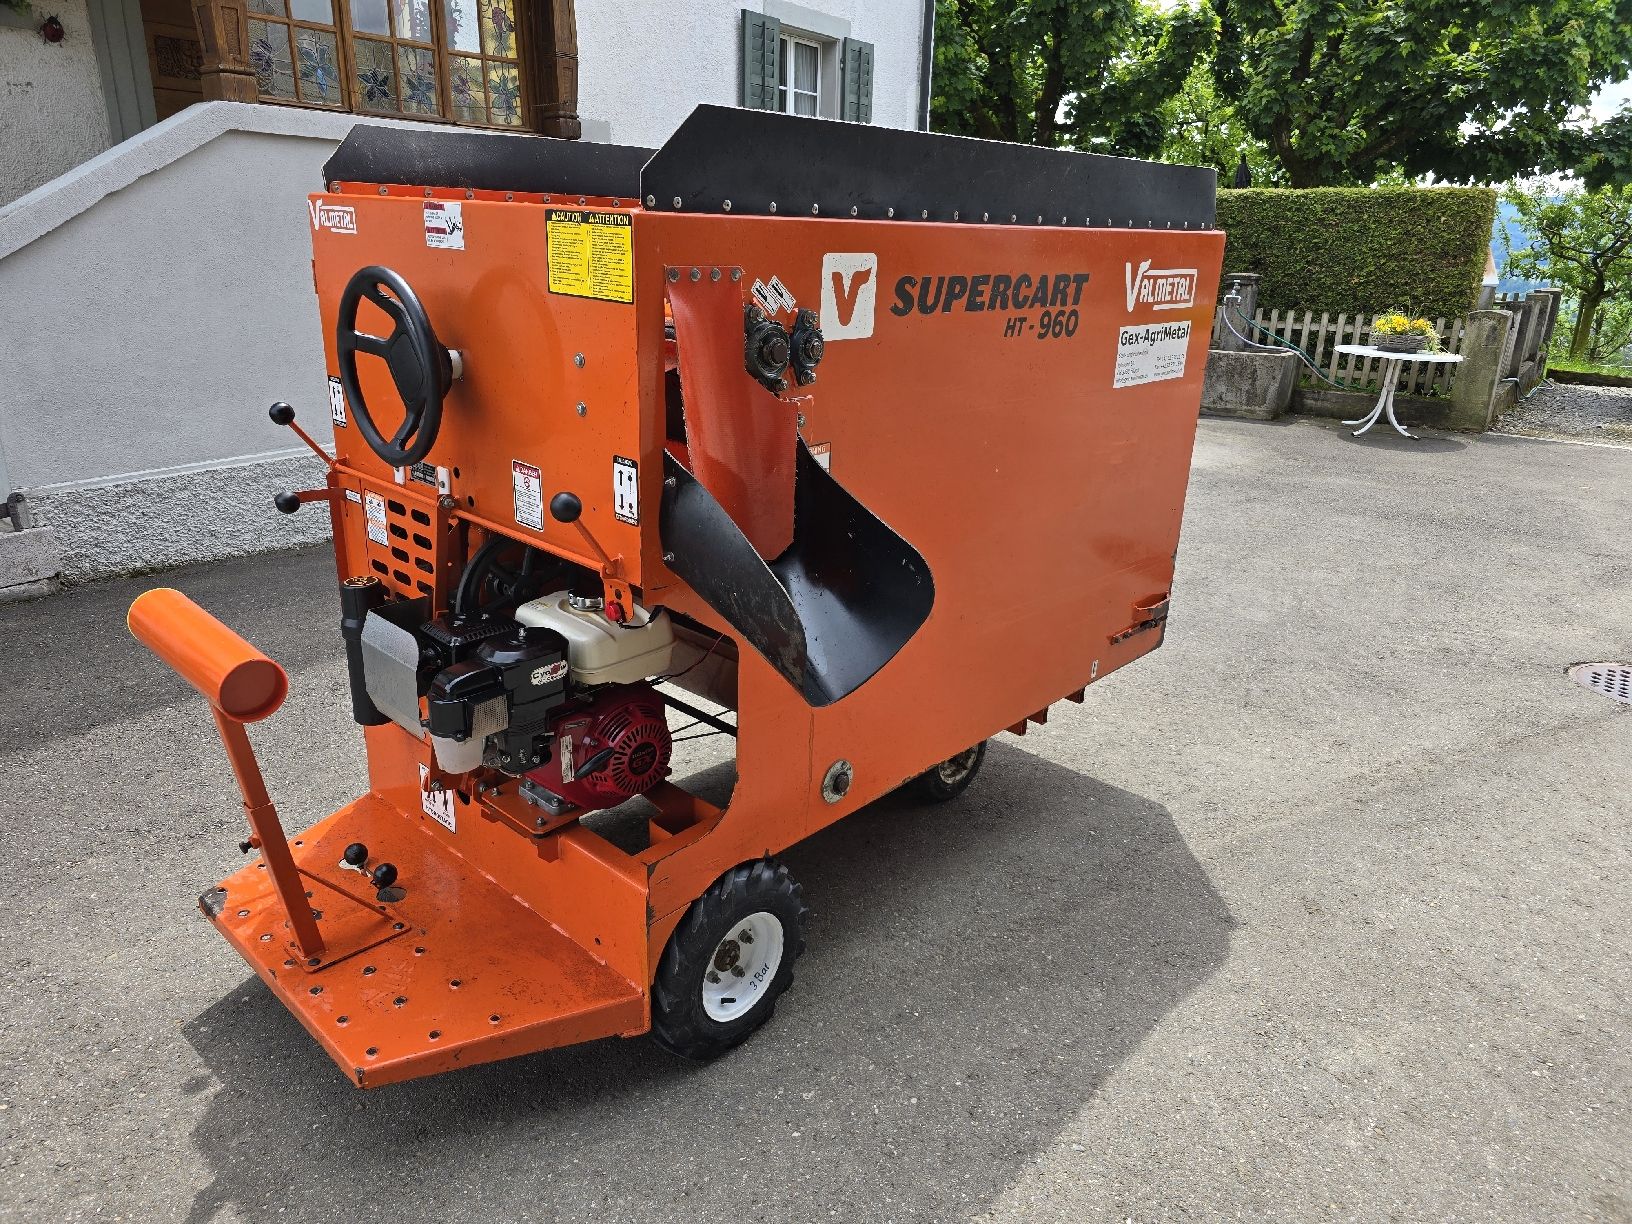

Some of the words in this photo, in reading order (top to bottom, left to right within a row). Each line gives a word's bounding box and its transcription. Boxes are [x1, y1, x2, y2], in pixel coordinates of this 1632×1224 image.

[307, 198, 354, 230] VALMETAL
[557, 211, 582, 222] CAUTION
[594, 213, 629, 226] ATTENTION
[890, 273, 1090, 317] SUPERCART
[1126, 258, 1190, 312] VALMETAL
[1120, 323, 1190, 347] Gex-AgriMetal
[750, 980, 758, 991] 3
[754, 962, 770, 982] Bar
